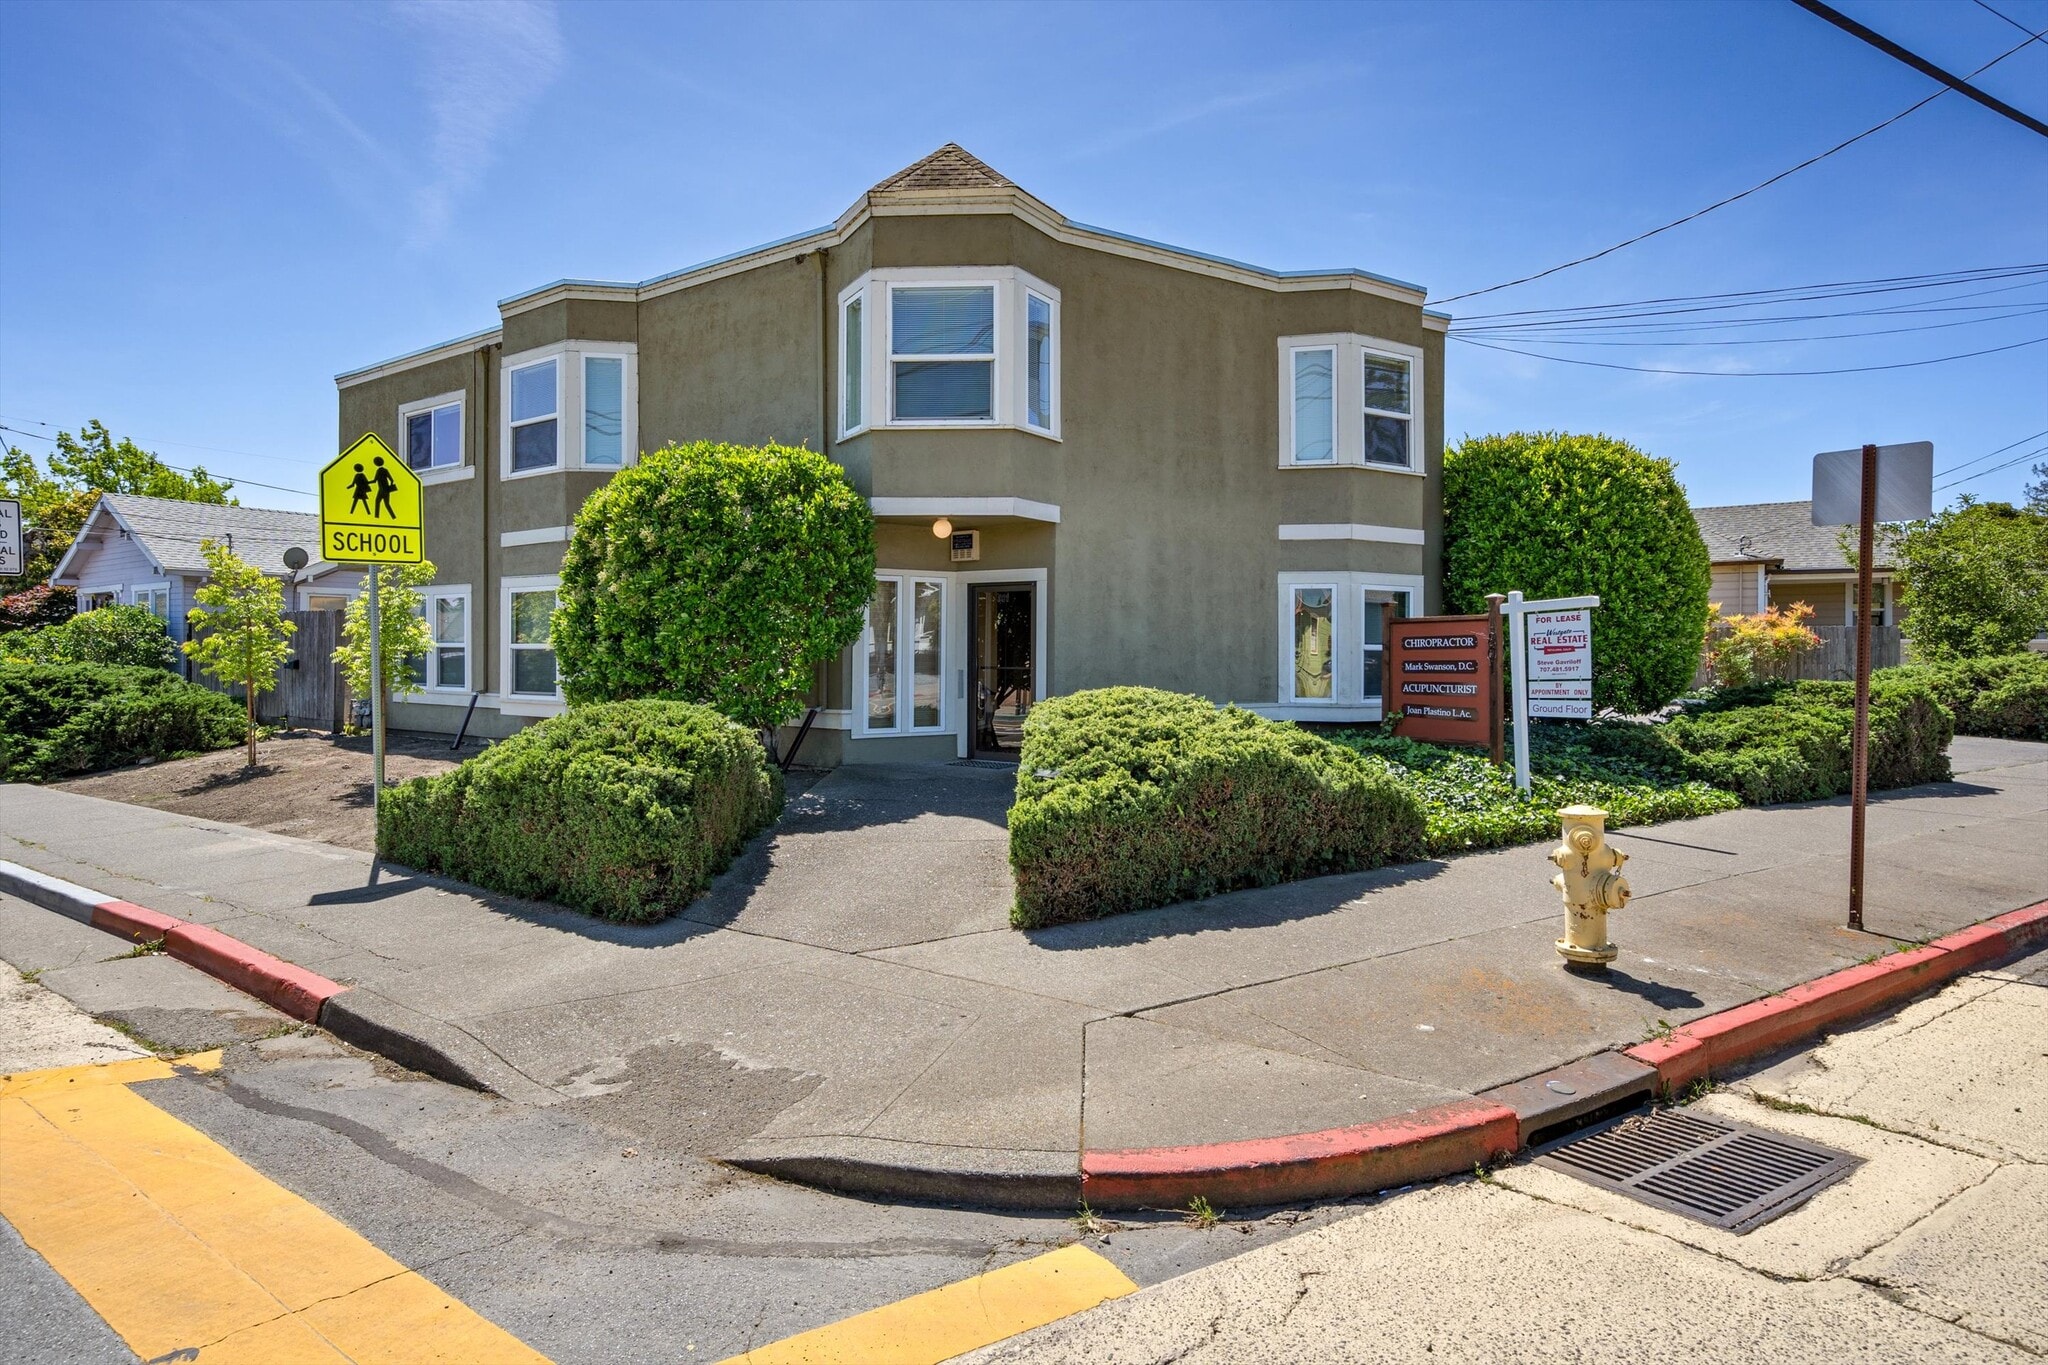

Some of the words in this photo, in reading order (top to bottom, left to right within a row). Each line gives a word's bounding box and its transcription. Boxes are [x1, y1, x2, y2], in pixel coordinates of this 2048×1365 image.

[333, 531, 414, 554] SCHOOL
[1536, 616, 1552, 624] FOR
[1556, 614, 1582, 622] LEASE
[1404, 637, 1474, 648] CHIROPRACTOR
[1531, 637, 1552, 645] REAL
[1557, 635, 1588, 644] ESTATE
[1405, 663, 1423, 671] Mark
[1423, 663, 1457, 672] Swanson,
[1458, 662, 1475, 670] D.C.
[1403, 683, 1478, 694] ACUPUNCTURIST
[1406, 706, 1422, 715] Joan
[1423, 707, 1451, 716] Plastino
[1452, 708, 1472, 718] L.Ac.
[1532, 704, 1563, 713] Ground
[1565, 704, 1588, 714] Floor
